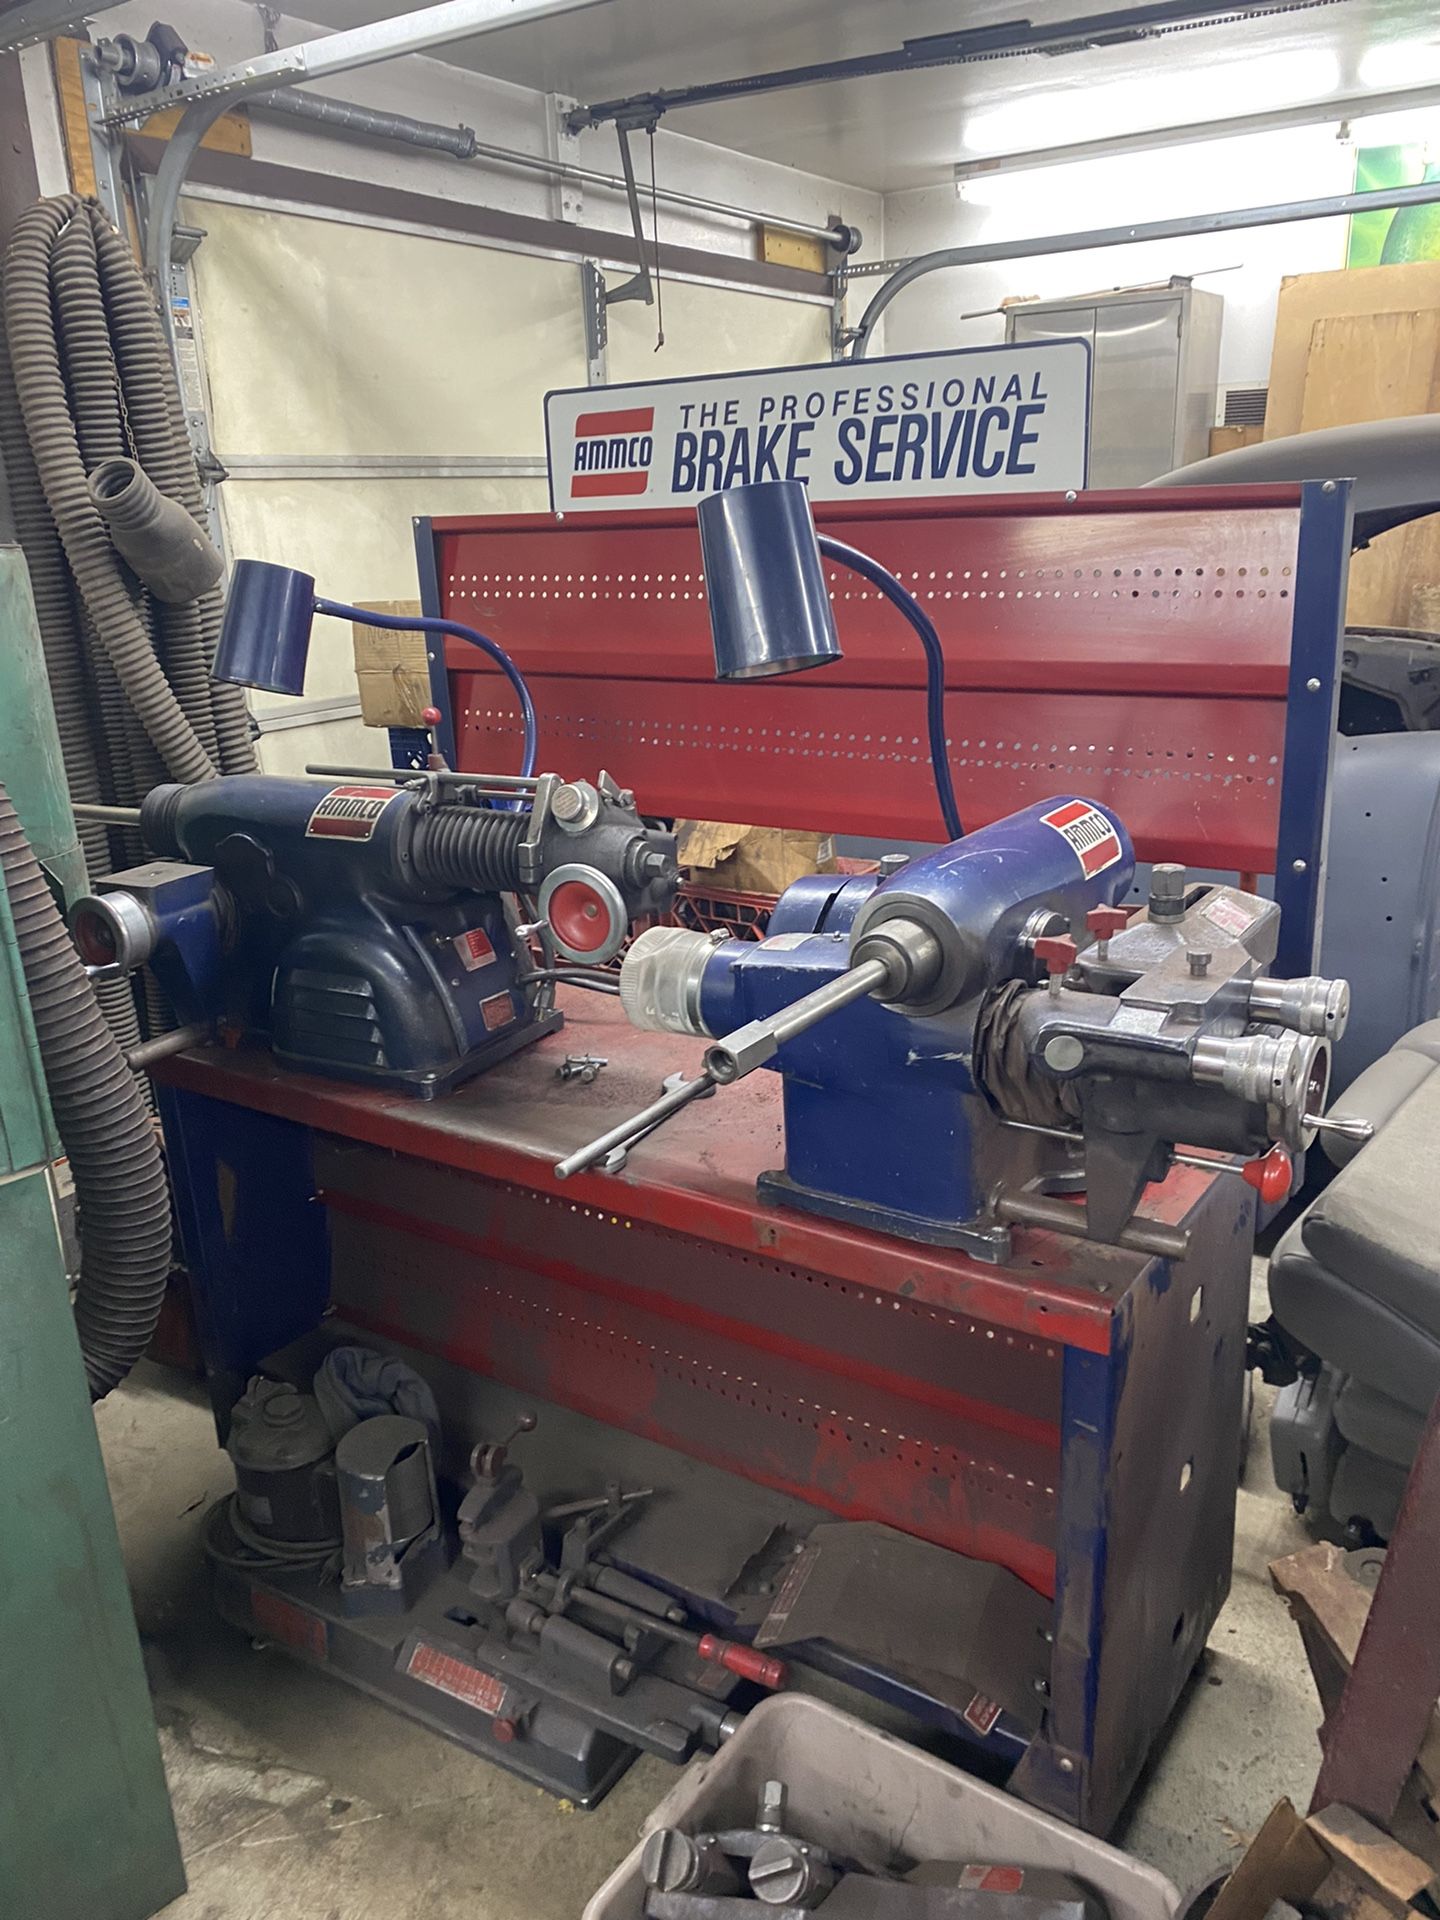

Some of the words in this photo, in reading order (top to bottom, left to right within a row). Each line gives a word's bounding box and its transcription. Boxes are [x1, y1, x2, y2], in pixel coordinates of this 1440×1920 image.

[679, 400, 740, 429] THE
[759, 372, 1048, 422] PROFESSIONAL
[574, 436, 653, 471] AMMCO
[671, 421, 816, 493] BRAKE
[834, 404, 1045, 485] SERVICE
[315, 797, 386, 819] AMMCO
[1063, 813, 1112, 851] AMMCO
